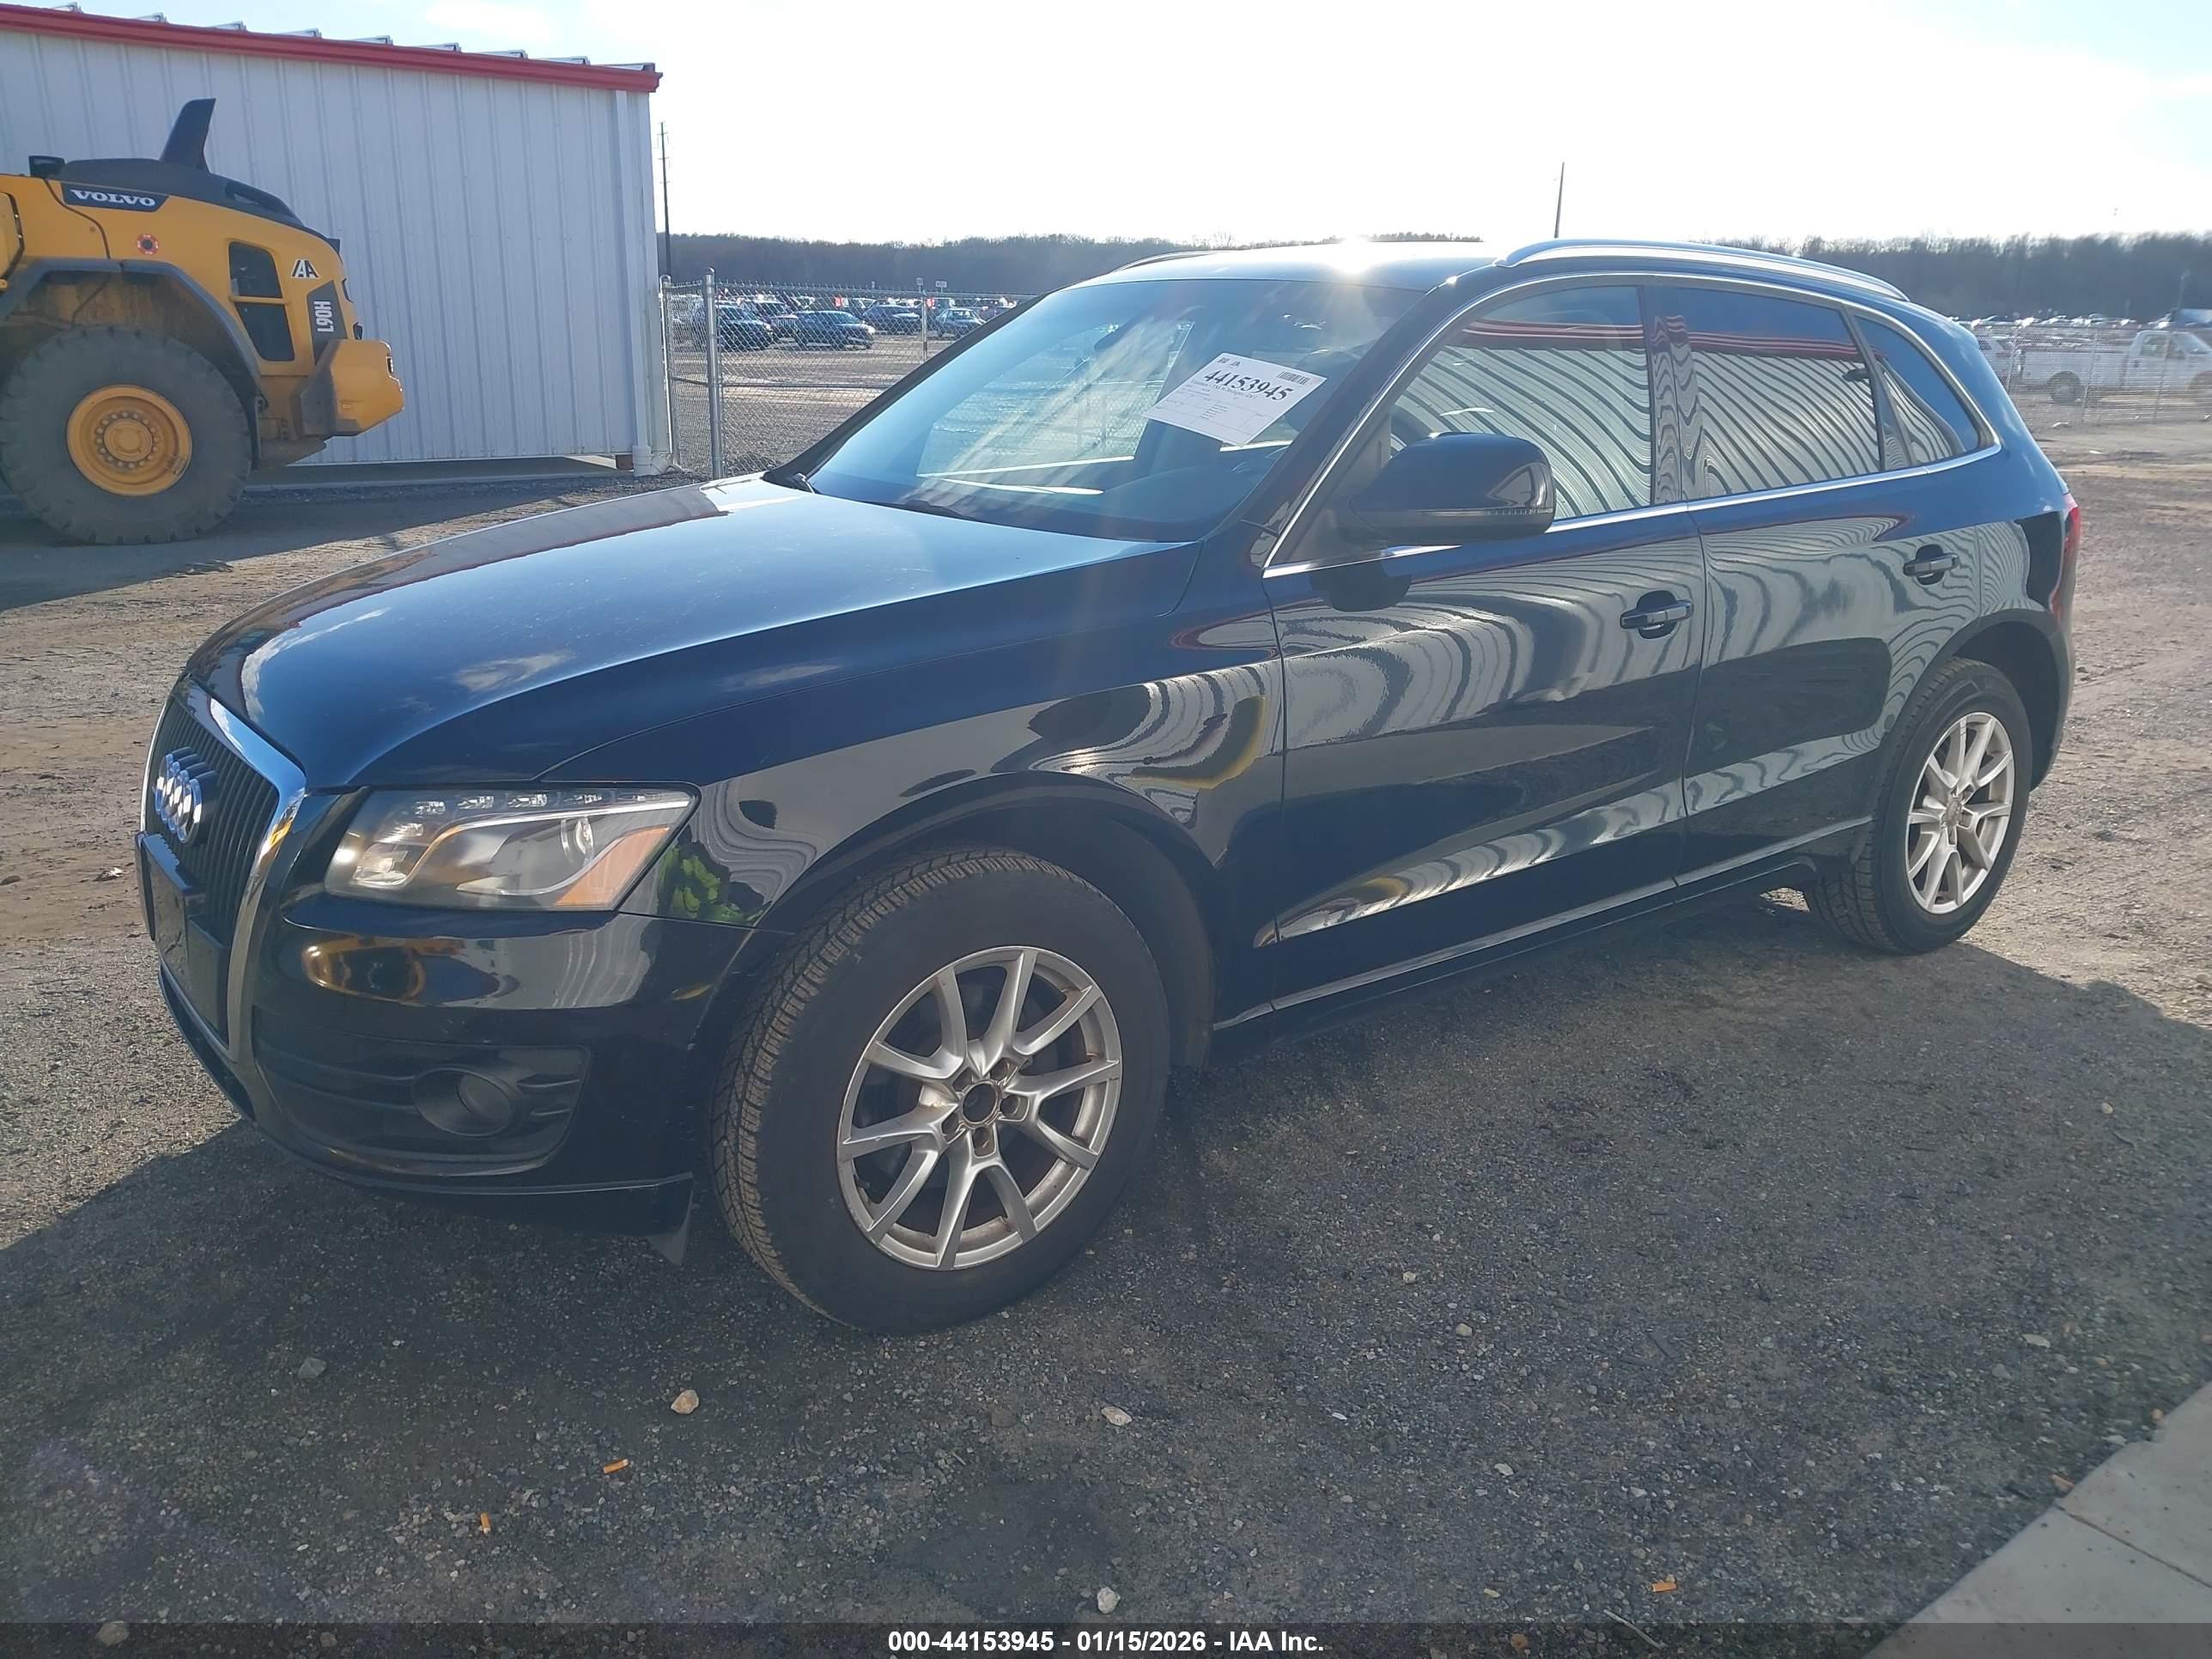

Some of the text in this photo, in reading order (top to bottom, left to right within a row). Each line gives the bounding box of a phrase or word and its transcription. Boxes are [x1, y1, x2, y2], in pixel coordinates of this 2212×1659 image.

[70, 189, 156, 207] VOLVO
[313, 301, 335, 333] L90H
[1204, 370, 1294, 401] 44153945
